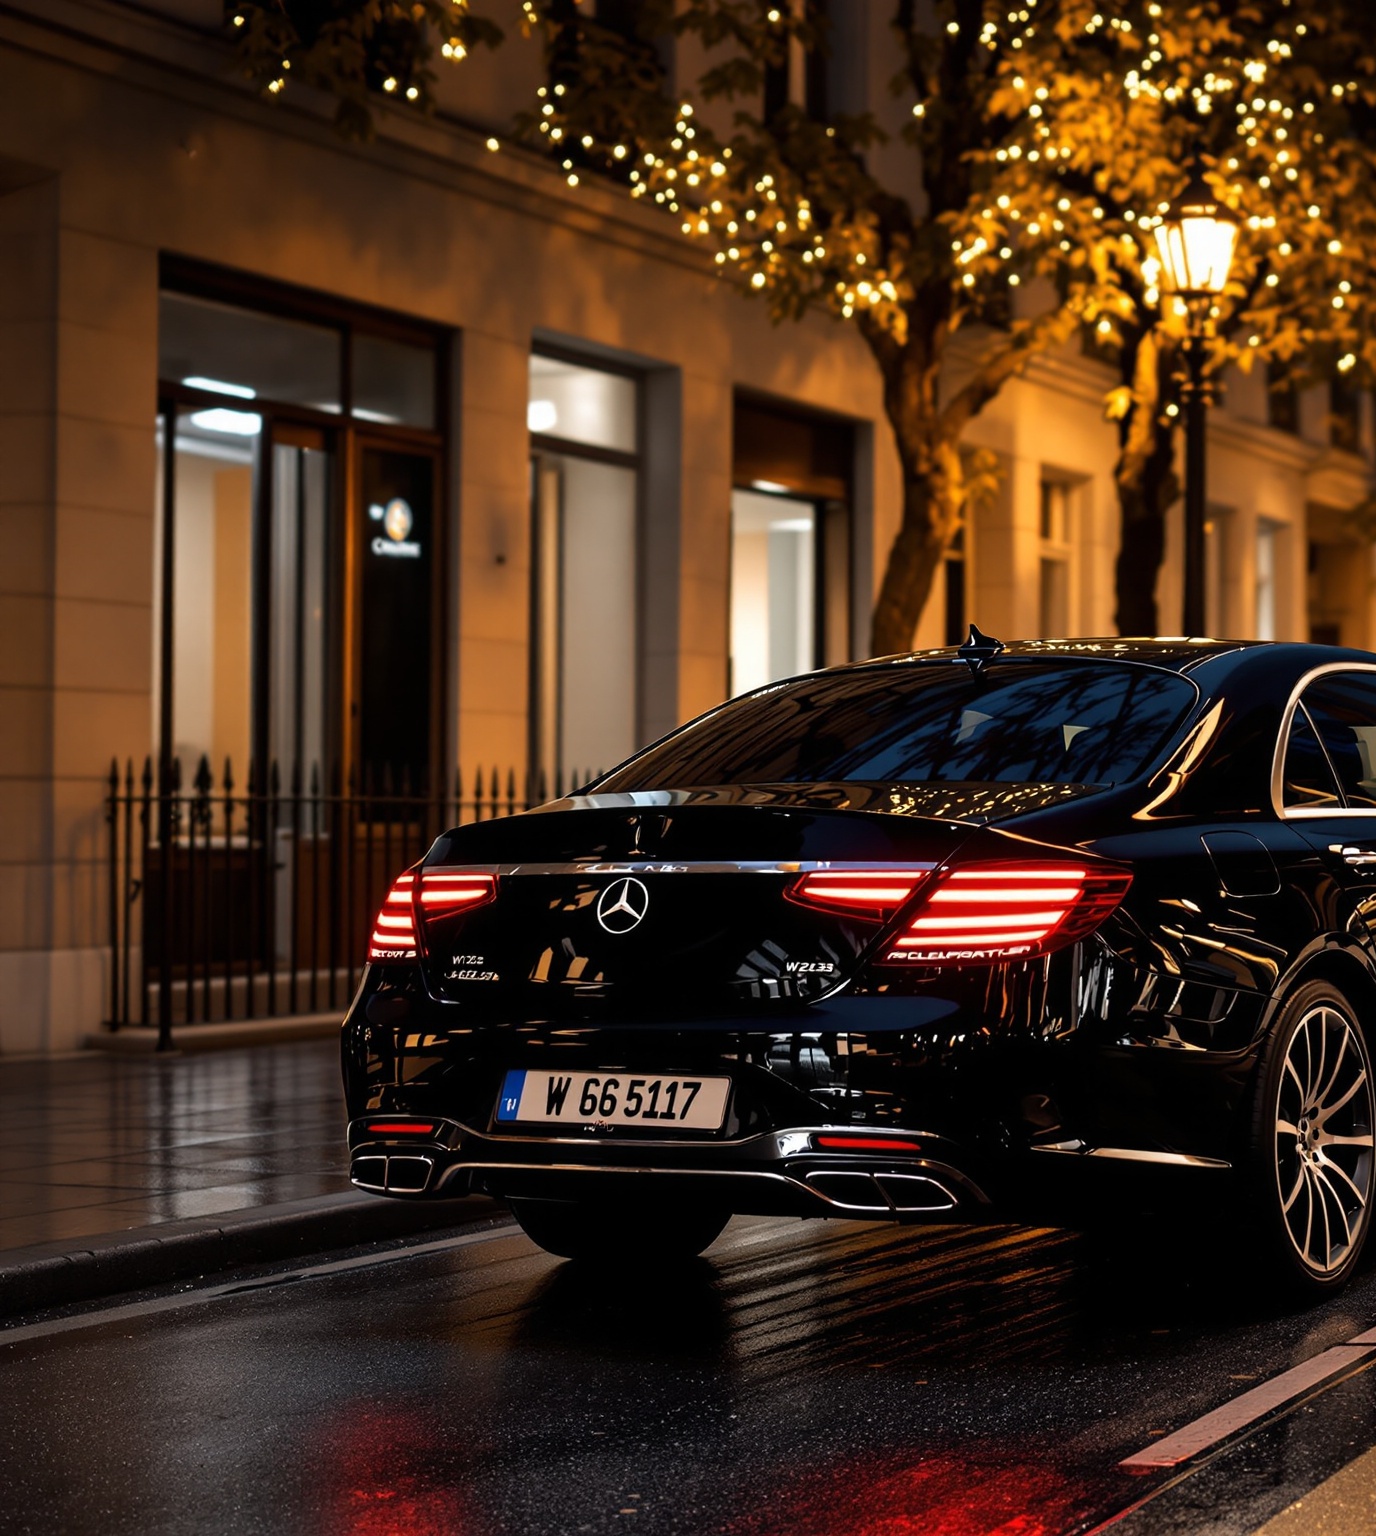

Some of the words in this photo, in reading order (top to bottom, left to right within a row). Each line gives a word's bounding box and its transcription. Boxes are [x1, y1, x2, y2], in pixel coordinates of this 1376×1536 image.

[545, 1076, 572, 1116] W
[579, 1078, 621, 1117] 66
[623, 1080, 702, 1120] 5117
